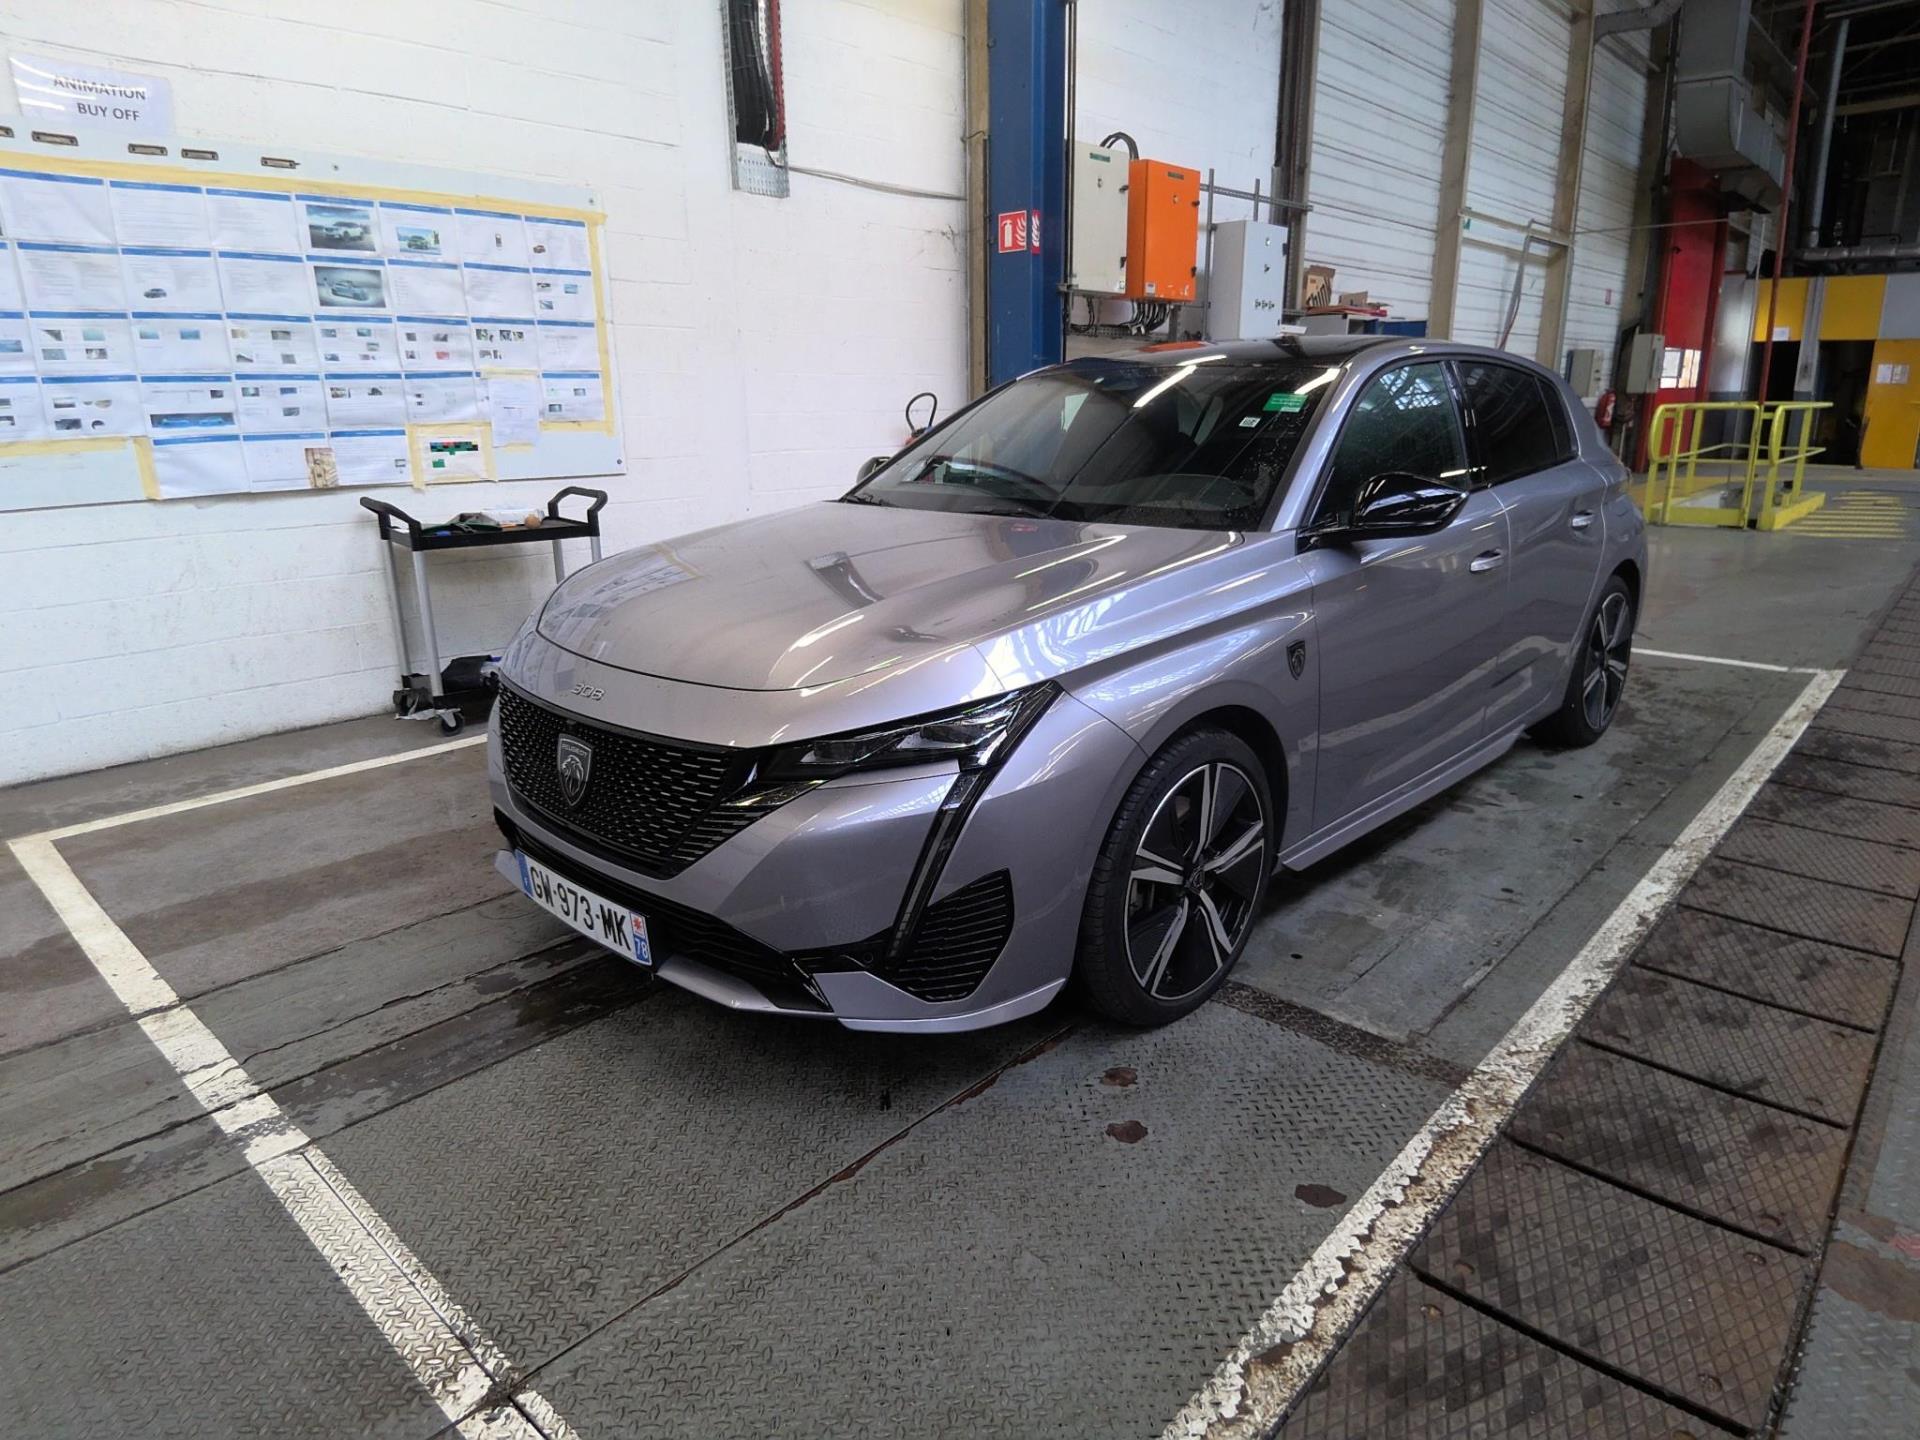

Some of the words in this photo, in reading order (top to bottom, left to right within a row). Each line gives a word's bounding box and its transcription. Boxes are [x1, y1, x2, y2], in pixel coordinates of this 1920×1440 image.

[53, 76, 146, 100] ANIMATION
[77, 102, 108, 118] BUY
[112, 108, 141, 122] OFF
[570, 683, 605, 701] 308
[530, 866, 631, 951] GW-973-MK
[634, 937, 649, 960] 78
